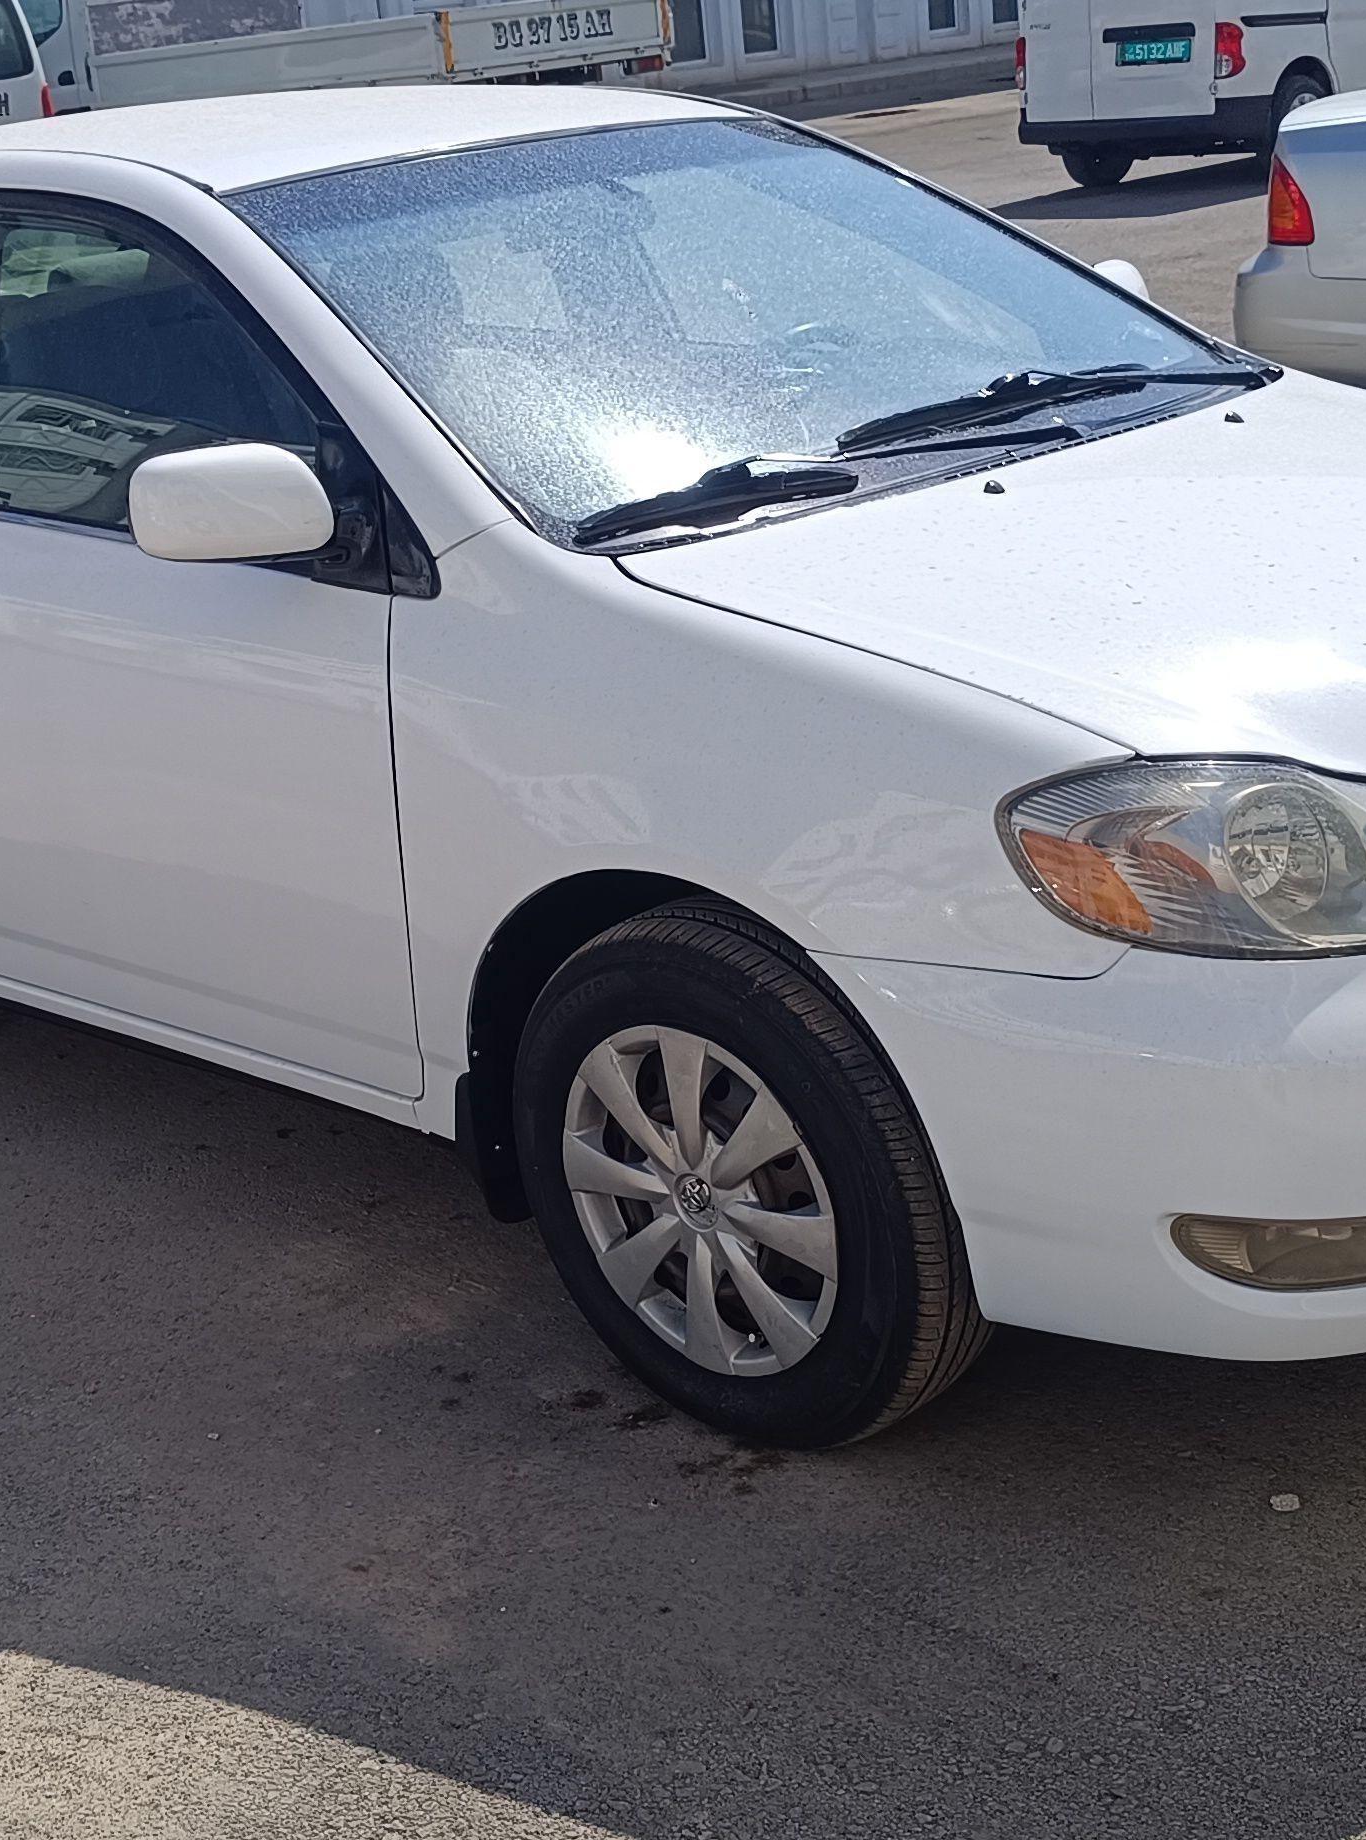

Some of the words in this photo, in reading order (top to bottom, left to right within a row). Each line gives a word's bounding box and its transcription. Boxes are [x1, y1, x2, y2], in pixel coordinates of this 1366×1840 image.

[491, 20, 523, 50] BG
[556, 13, 580, 41] 15
[584, 9, 614, 38] AH
